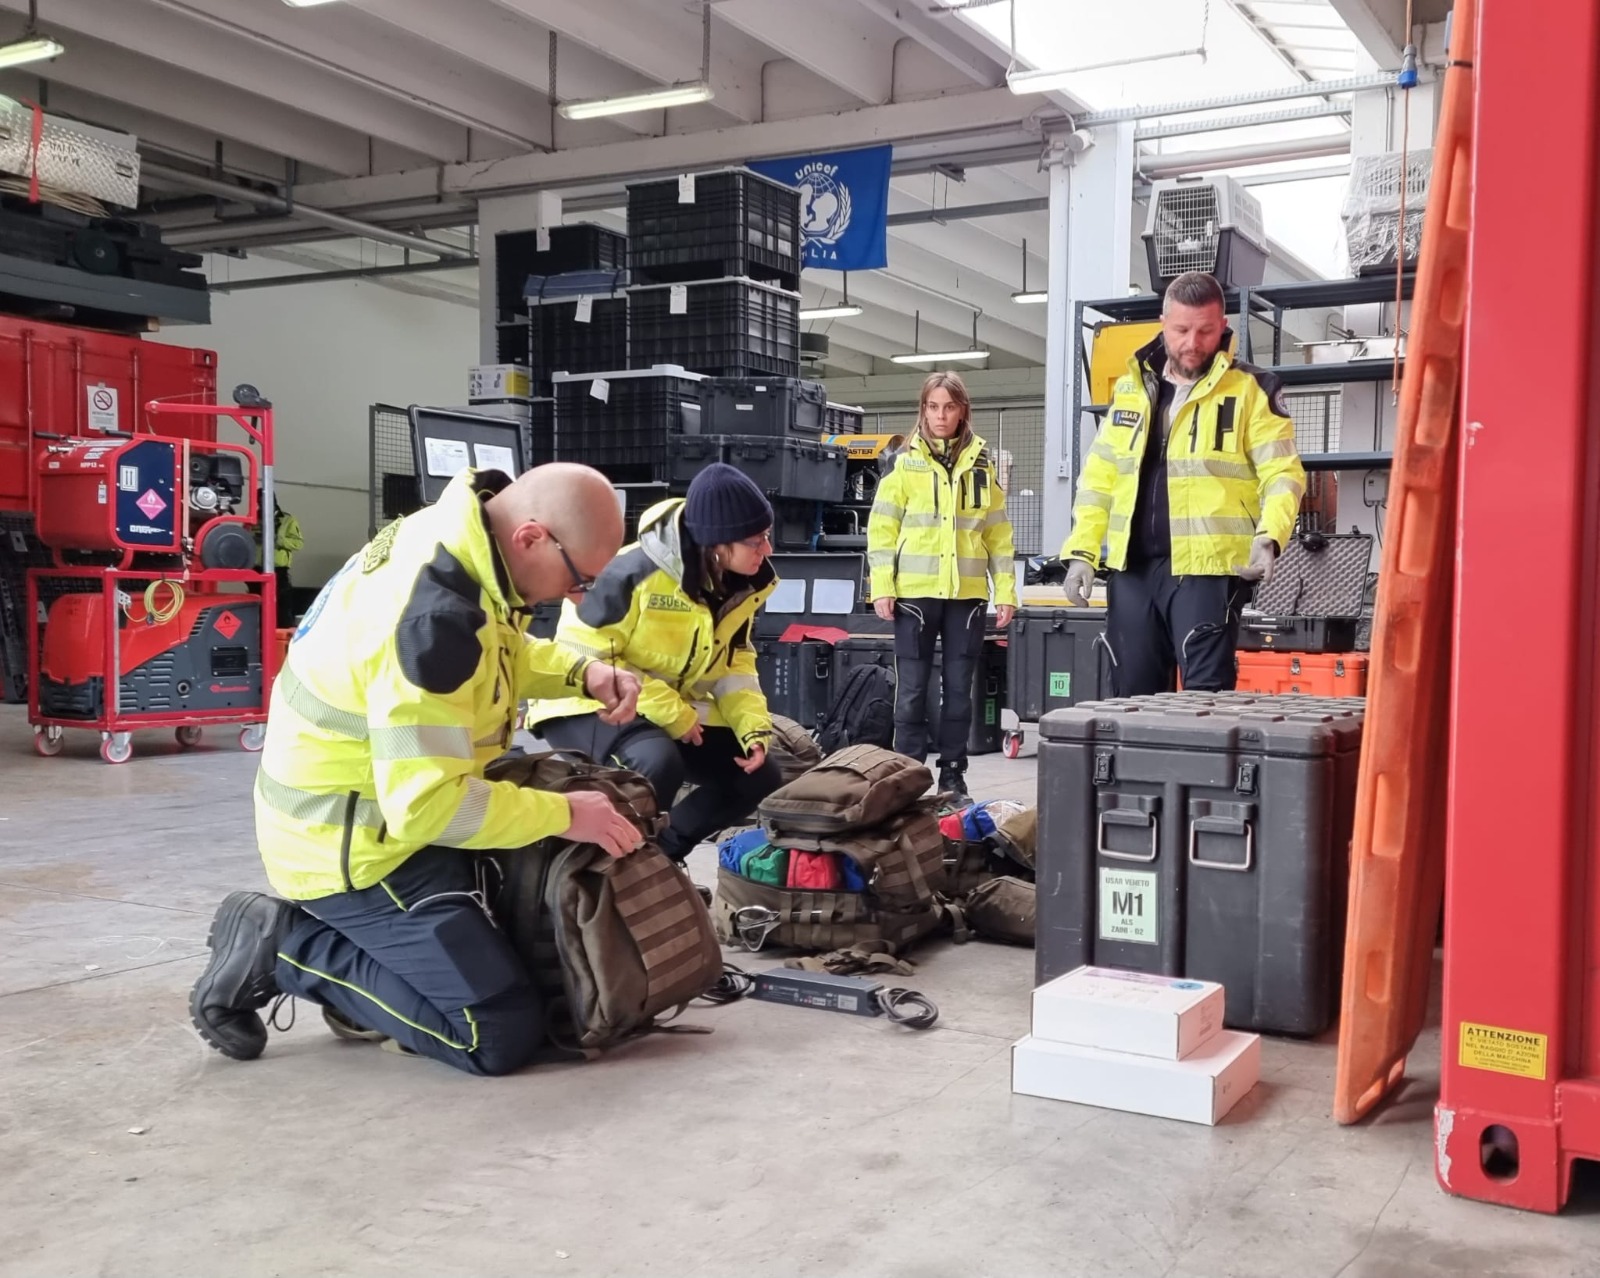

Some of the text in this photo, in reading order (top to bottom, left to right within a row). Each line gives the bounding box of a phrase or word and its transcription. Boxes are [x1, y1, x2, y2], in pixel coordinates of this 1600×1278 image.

[795, 162, 838, 180] unicef
[1054, 680, 1065, 690] 10
[1105, 876, 1150, 887] USAR VENETO
[1112, 891, 1143, 916] M1
[1121, 918, 1134, 926] ALS
[1467, 1027, 1541, 1046] ATTENZIONE
[1477, 1038, 1505, 1047] VIETATO
[1506, 1042, 1537, 1052] SOSTARE
[1473, 1050, 1496, 1059] DELLA
[1496, 1053, 1532, 1064] MACCHINA
[1480, 1045, 1506, 1054] RAGGIO
[1516, 1050, 1540, 1060] AZIONE
